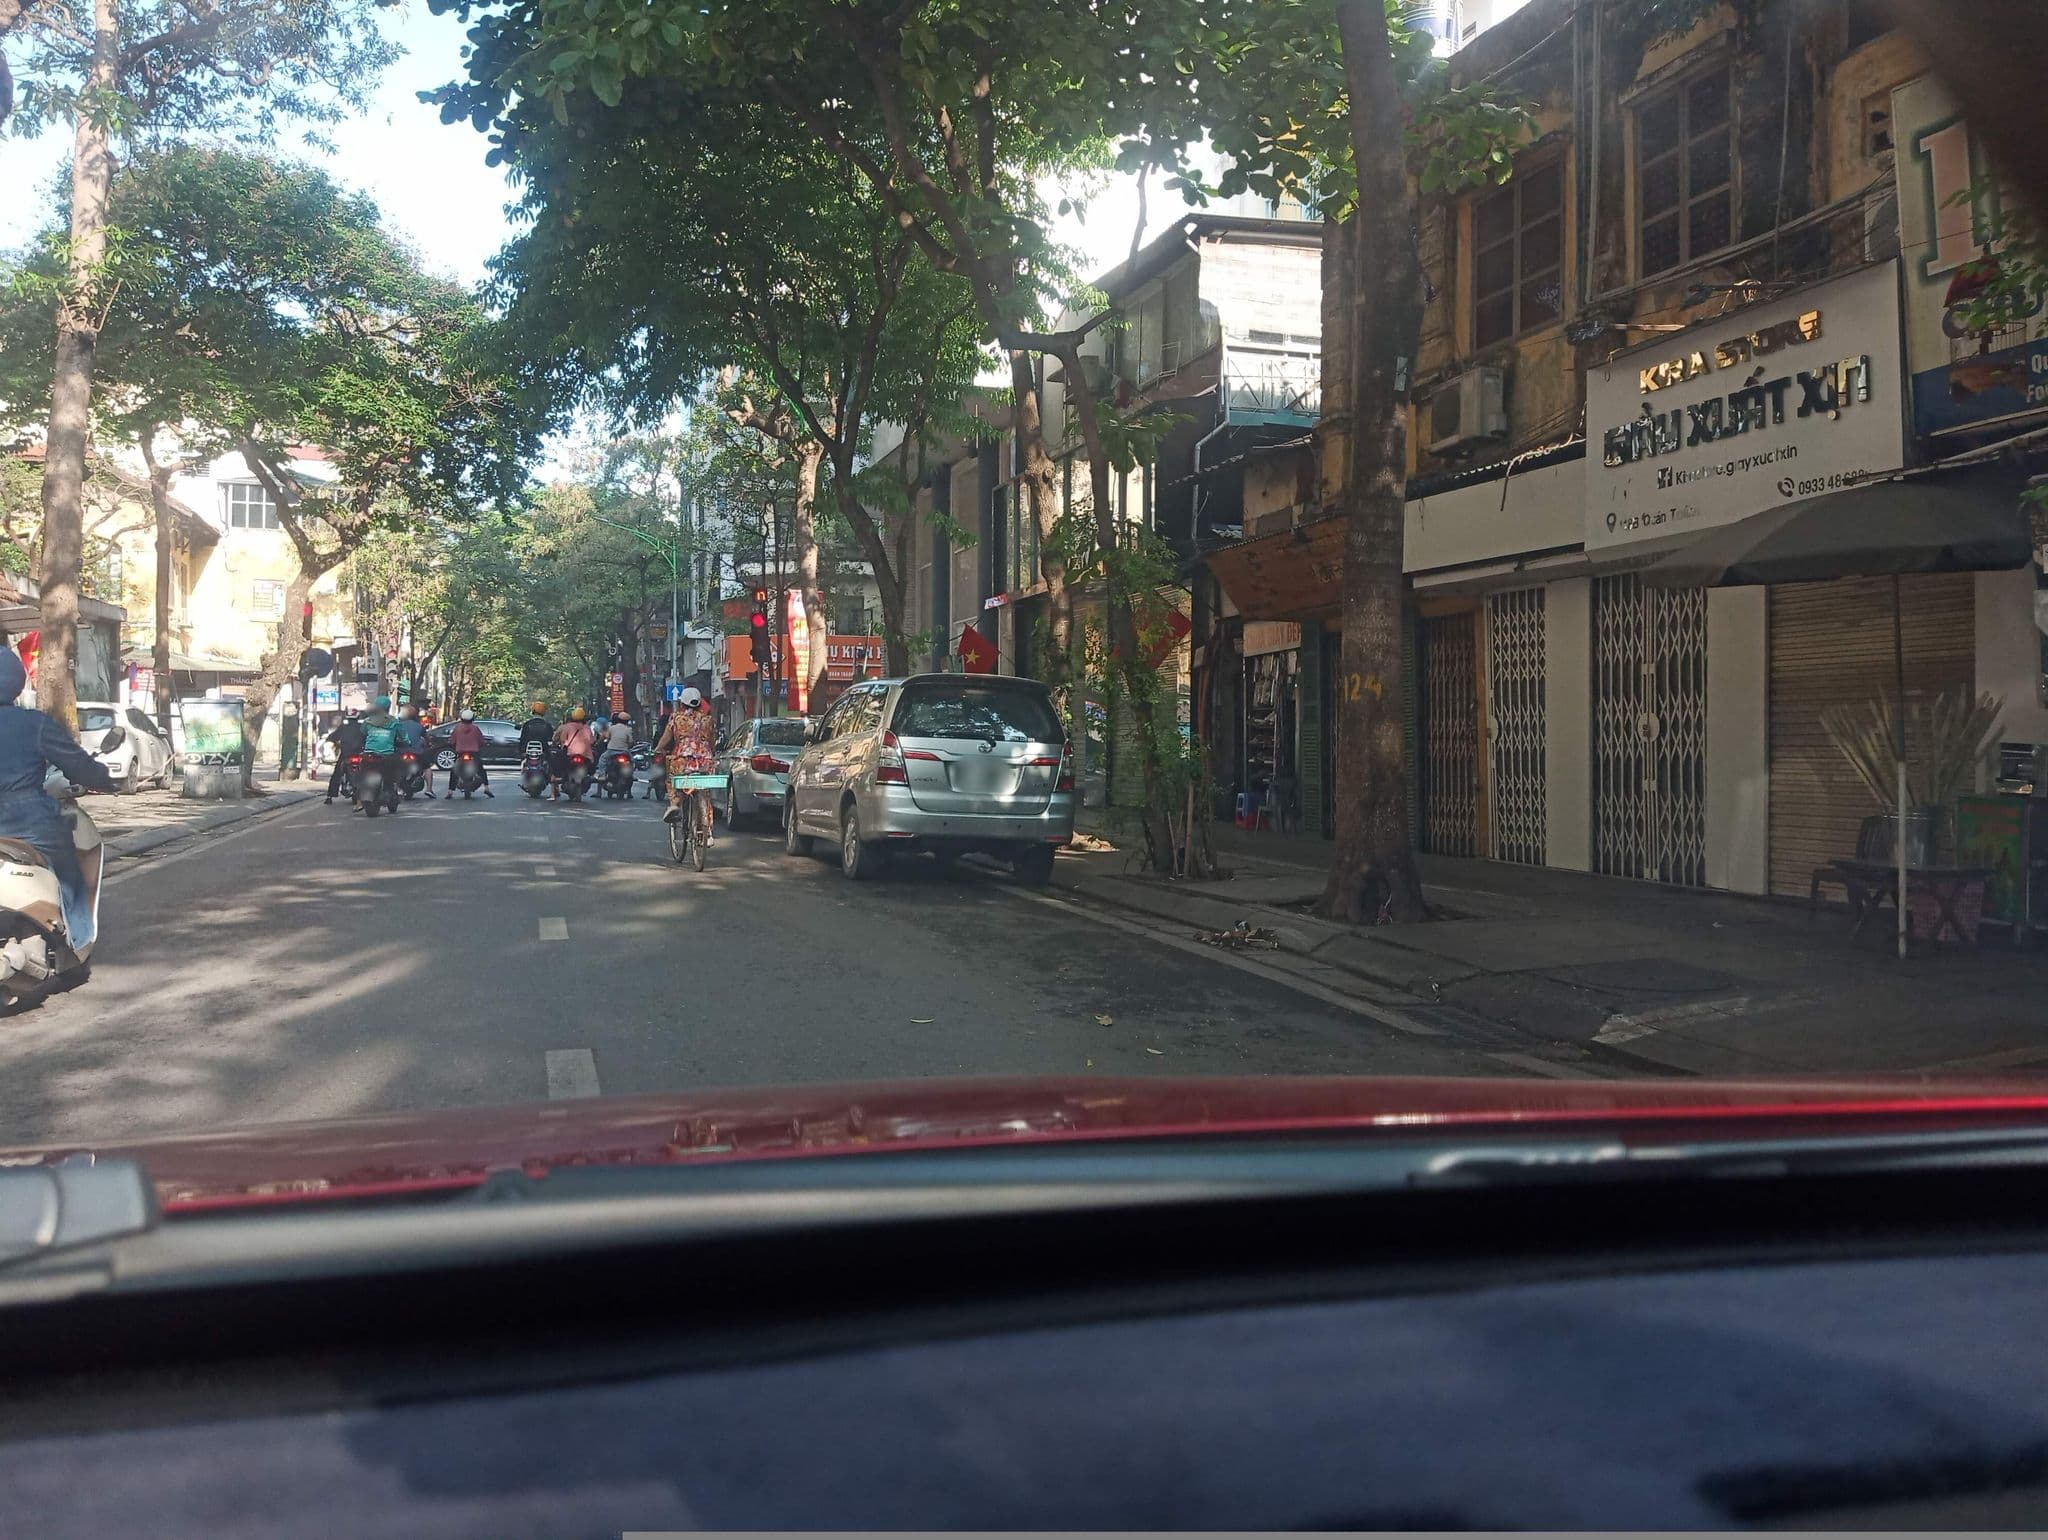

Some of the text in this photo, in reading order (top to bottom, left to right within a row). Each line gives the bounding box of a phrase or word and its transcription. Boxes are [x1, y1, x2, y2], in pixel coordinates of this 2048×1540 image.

[1638, 309, 1824, 395] KRA STORE
[1798, 476, 1826, 496] 0933
